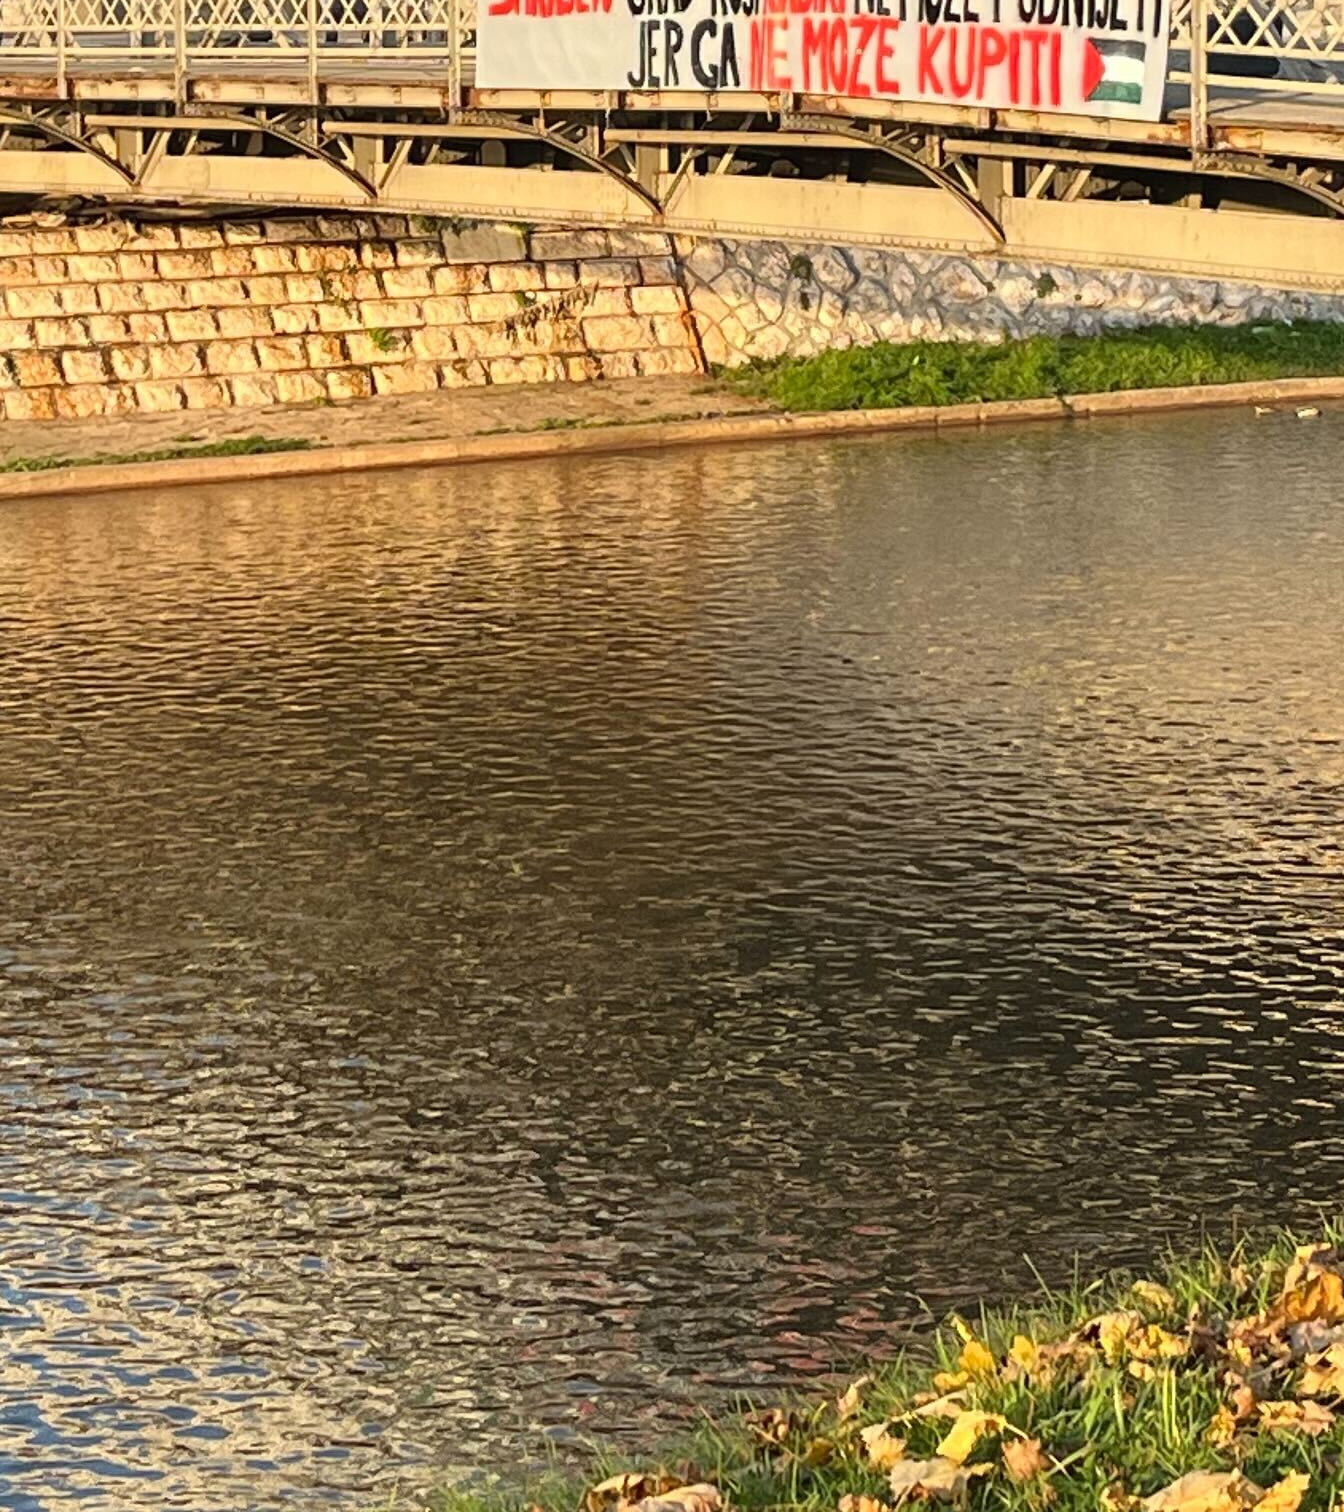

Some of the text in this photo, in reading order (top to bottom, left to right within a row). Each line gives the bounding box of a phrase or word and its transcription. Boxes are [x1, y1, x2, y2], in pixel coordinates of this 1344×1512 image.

[627, 19, 684, 88] JER
[690, 19, 740, 88] GA
[750, 17, 793, 90] NE
[918, 25, 1062, 106] KUPITI
